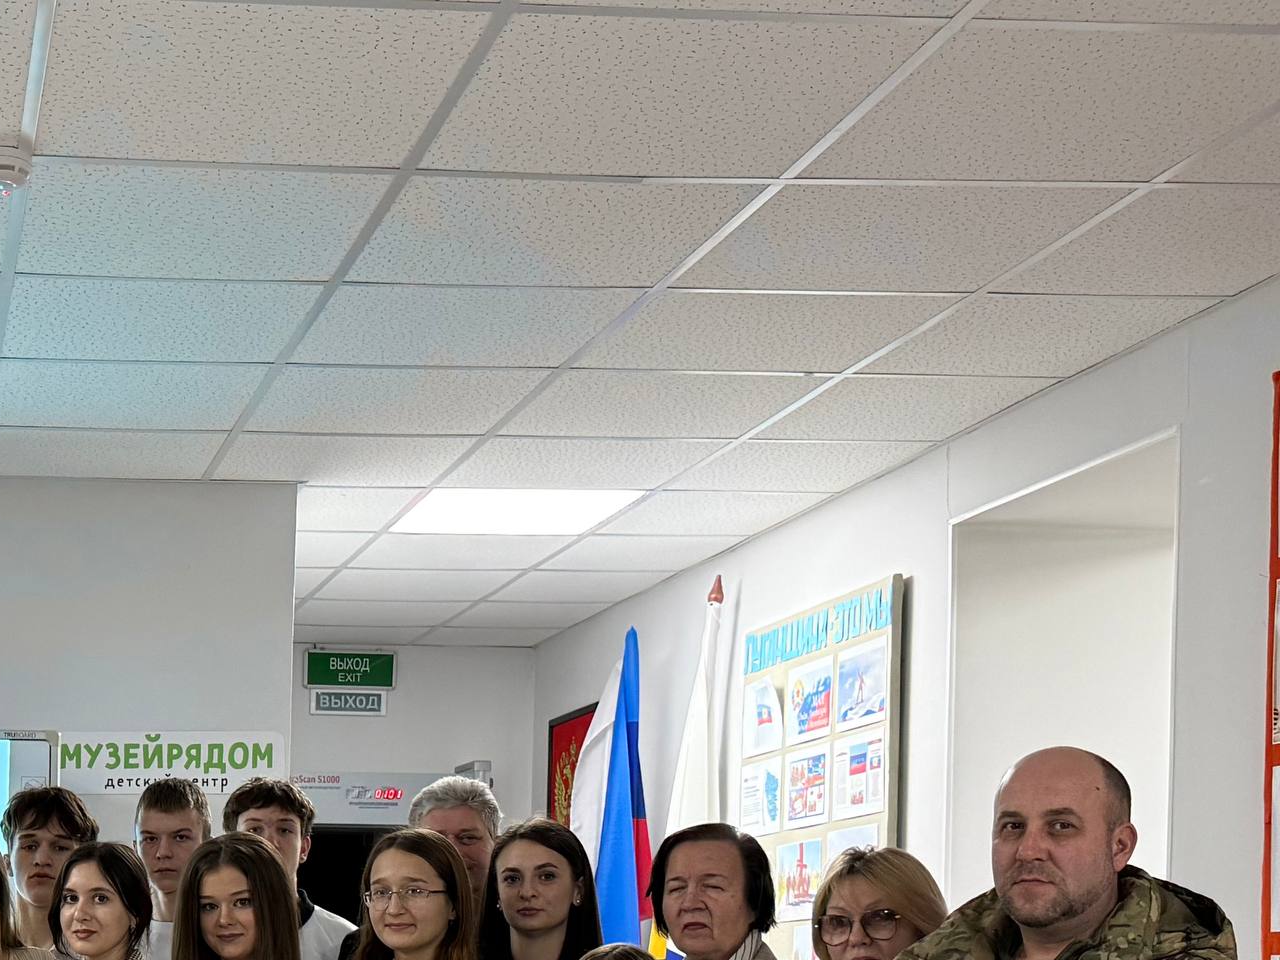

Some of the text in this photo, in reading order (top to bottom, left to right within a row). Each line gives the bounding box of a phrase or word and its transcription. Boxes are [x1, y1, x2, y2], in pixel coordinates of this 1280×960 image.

[329, 657, 370, 673] ВЫХОД
[338, 672, 362, 682] EXIT
[320, 695, 379, 709] ВЫХОД
[61, 733, 273, 774] МУЗЕЙРЯДОМ
